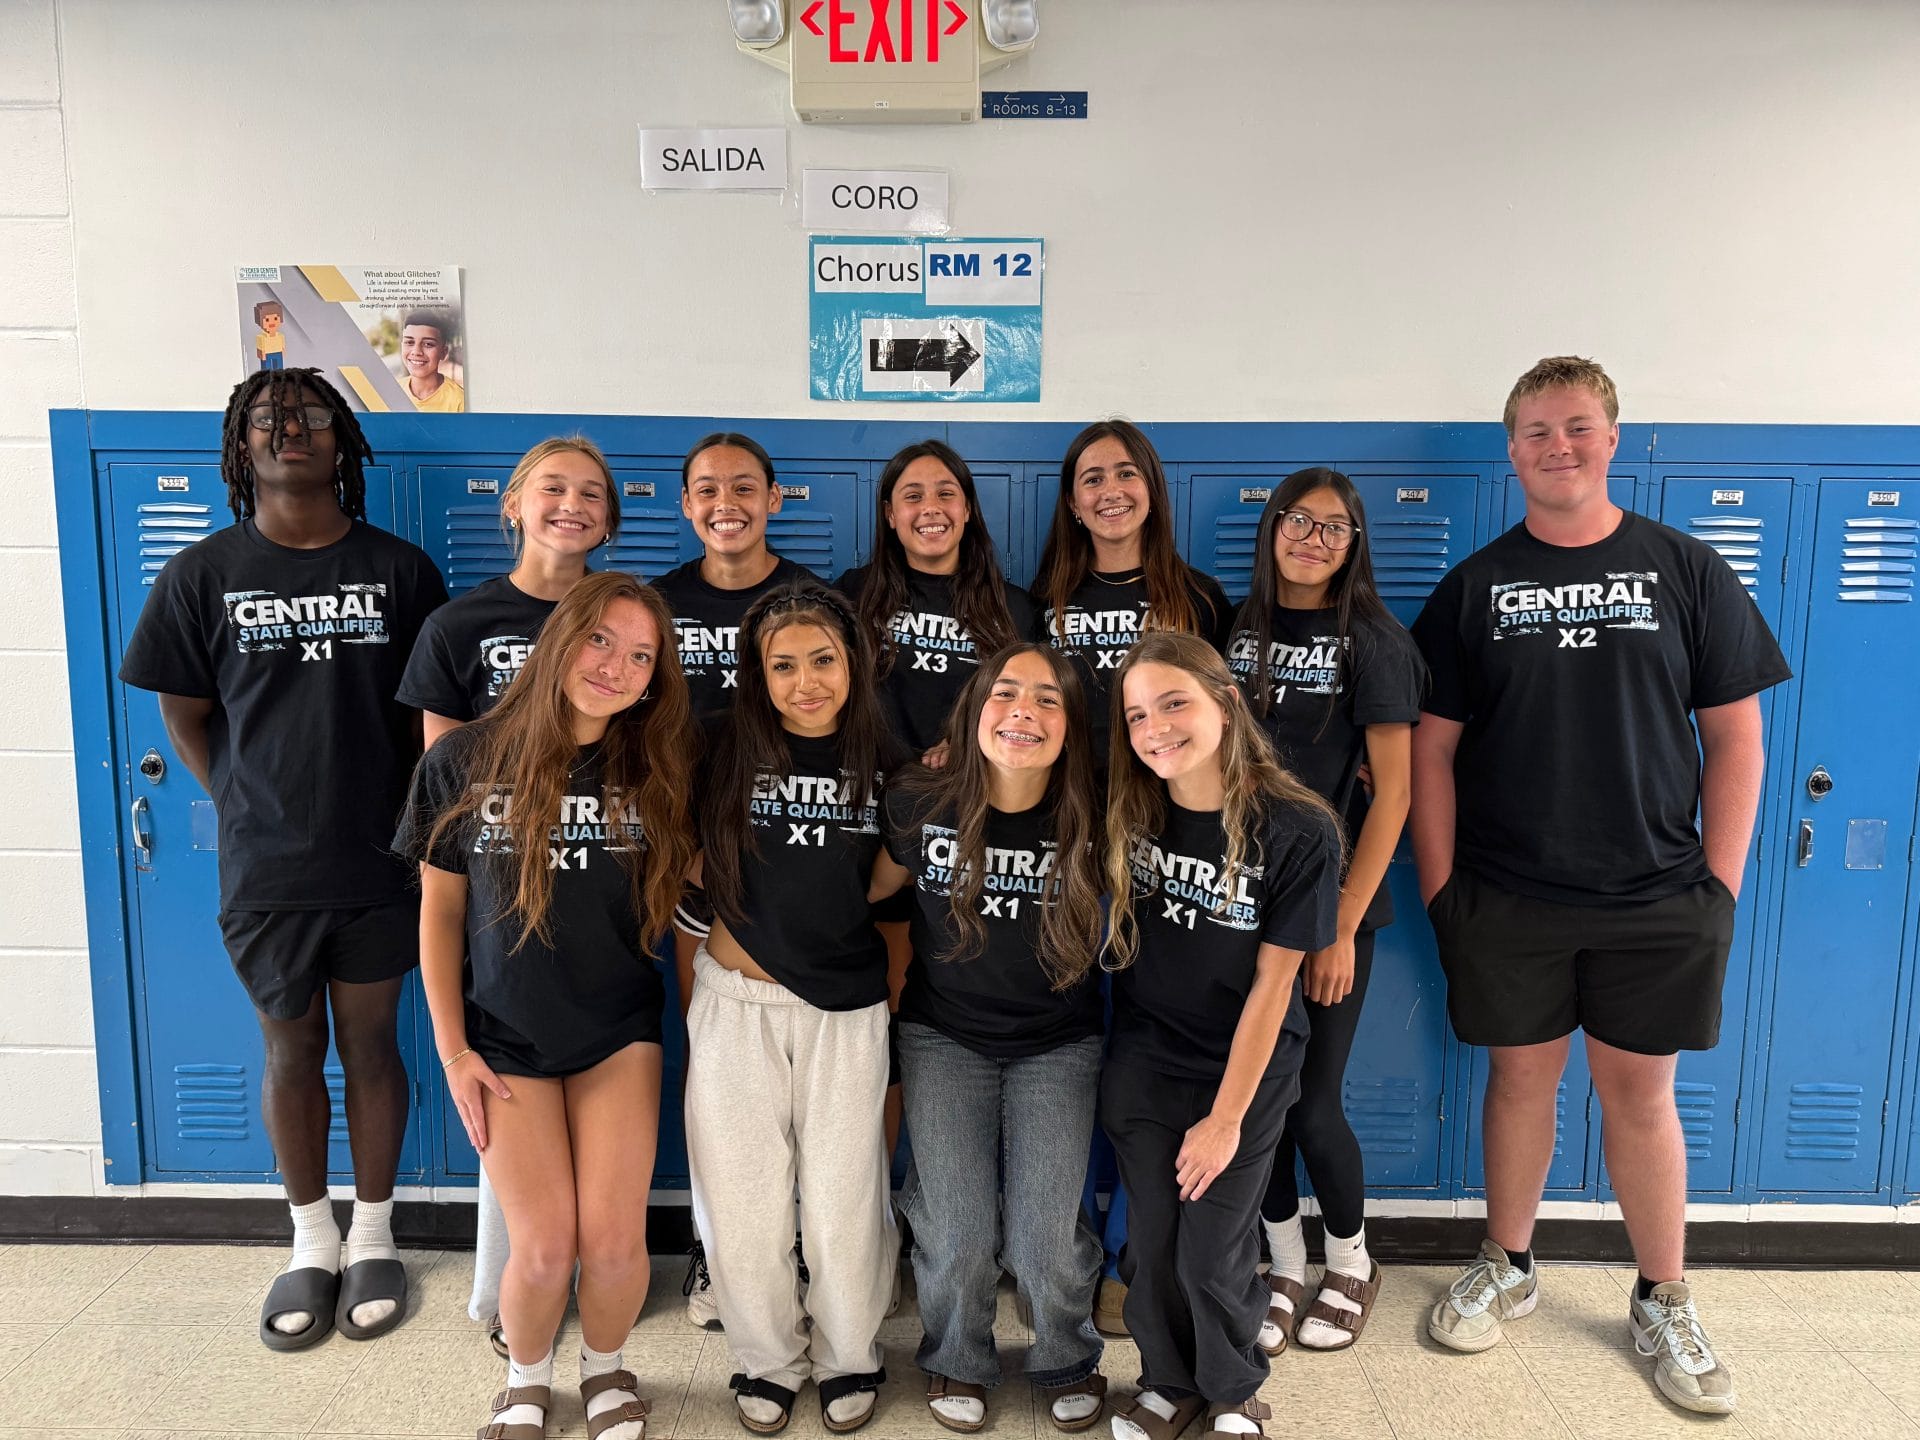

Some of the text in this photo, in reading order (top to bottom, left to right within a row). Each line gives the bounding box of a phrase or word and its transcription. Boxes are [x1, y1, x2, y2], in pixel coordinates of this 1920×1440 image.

[993, 104, 1076, 115] ROOMS 8-13
[661, 147, 765, 173] SALIDA
[831, 184, 919, 211] CORO
[364, 270, 441, 278] What about Glitches?
[817, 255, 920, 283] Chorus
[929, 253, 1032, 277] RM 12
[1498, 581, 1652, 614] CENTRAL
[235, 594, 382, 627] CENTRAL
[1500, 605, 1653, 628] STATE QUALIFIER
[240, 620, 385, 642] STATE QUALIFIER
[1558, 627, 1598, 649] X2
[300, 640, 333, 662] X1
[678, 651, 715, 665] TATE
[910, 650, 949, 674] X3
[786, 824, 826, 847] X1
[546, 847, 589, 870] X1
[980, 895, 1020, 920] X1
[1161, 897, 1198, 931] X1
